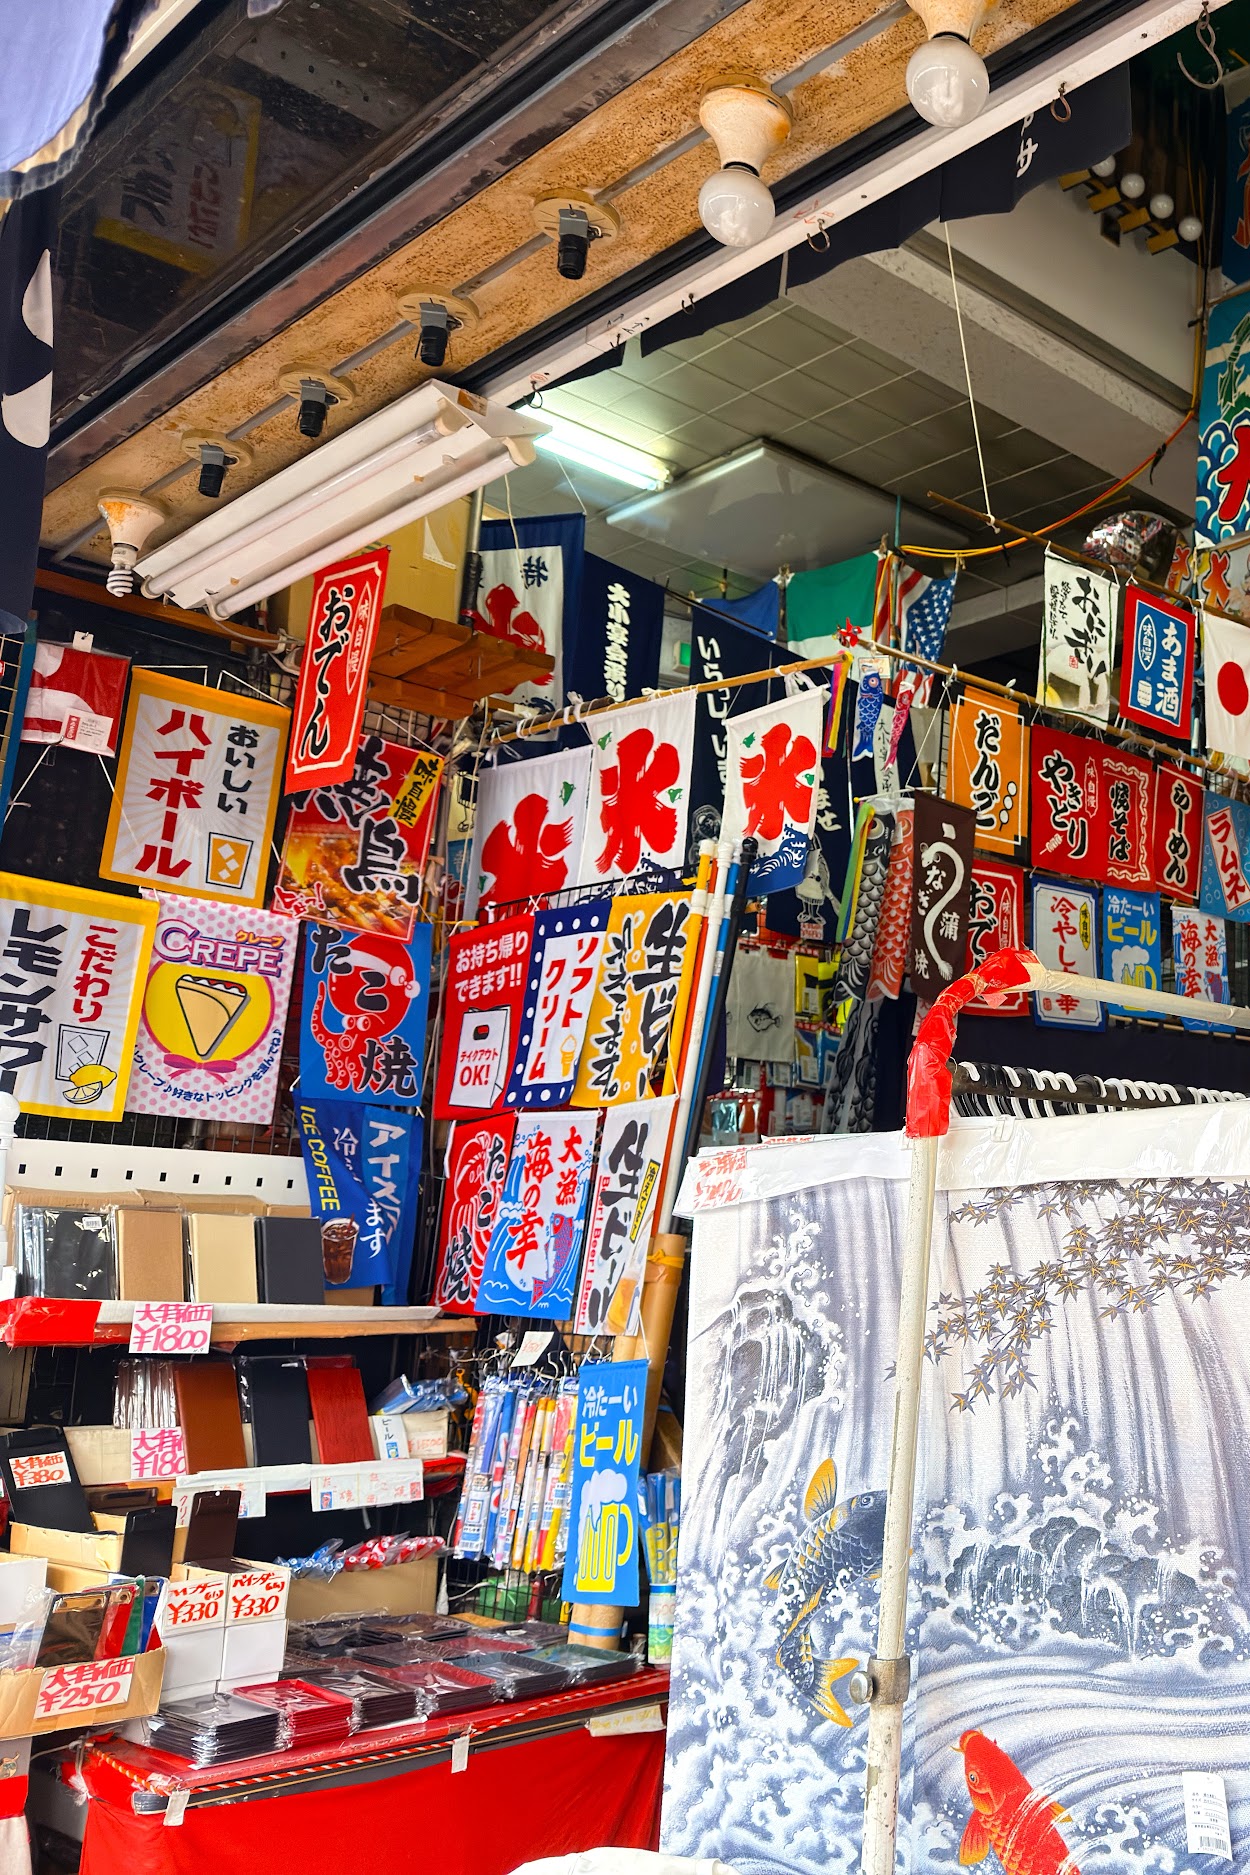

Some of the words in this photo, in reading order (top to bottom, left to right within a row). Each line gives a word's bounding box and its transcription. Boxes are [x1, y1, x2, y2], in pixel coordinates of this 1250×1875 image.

[299, 582, 356, 760] おでん
[1155, 621, 1183, 720] あま酒
[134, 707, 214, 879] ハイボール
[217, 725, 260, 815] おいしい
[739, 722, 817, 841] 氷
[970, 709, 1001, 831] だんご
[594, 728, 681, 874] 氷
[1039, 749, 1089, 859] やきとり
[1109, 780, 1131, 862] 焼そば
[1163, 778, 1193, 887] らーめん
[1211, 812, 1246, 905] ラムネ
[1106, 915, 1158, 946] ビール
[1107, 894, 1155, 917] 冷たーい
[154, 919, 284, 978] CREPE
[235, 930, 286, 948] クレープ
[456, 929, 529, 974] お持ち帰り
[1050, 895, 1081, 1016] 冷やし華
[1179, 921, 1202, 999] 海の幸
[1203, 918, 1220, 968] 大漁
[72, 924, 120, 1024] こだわり
[561, 937, 600, 1029] ソフト
[310, 923, 418, 1097] たこ焼
[528, 958, 564, 1080] クリーム
[459, 1064, 491, 1088] OK!
[460, 1047, 499, 1063] テイクアウト
[300, 1105, 322, 1136] ICE
[307, 1138, 341, 1212] COFFEE
[555, 1125, 583, 1206] 大漁
[443, 1132, 506, 1300] たこ焼
[506, 1131, 553, 1270] 海の幸
[588, 1227, 602, 1274] Beer!
[135, 1303, 214, 1323] 大特価
[578, 1284, 594, 1327] Beer!
[133, 1323, 208, 1352] ¥1800
[381, 1418, 395, 1441] ビール
[582, 1385, 639, 1418] 冷たーい
[12, 1453, 64, 1470] 大特価
[580, 1419, 640, 1468] ビール
[13, 1469, 65, 1487] ¥380
[167, 1600, 219, 1625] ¥330
[231, 1594, 280, 1619] ¥330
[38, 1680, 122, 1713] ¥250
[47, 1657, 135, 1689] 大特価
